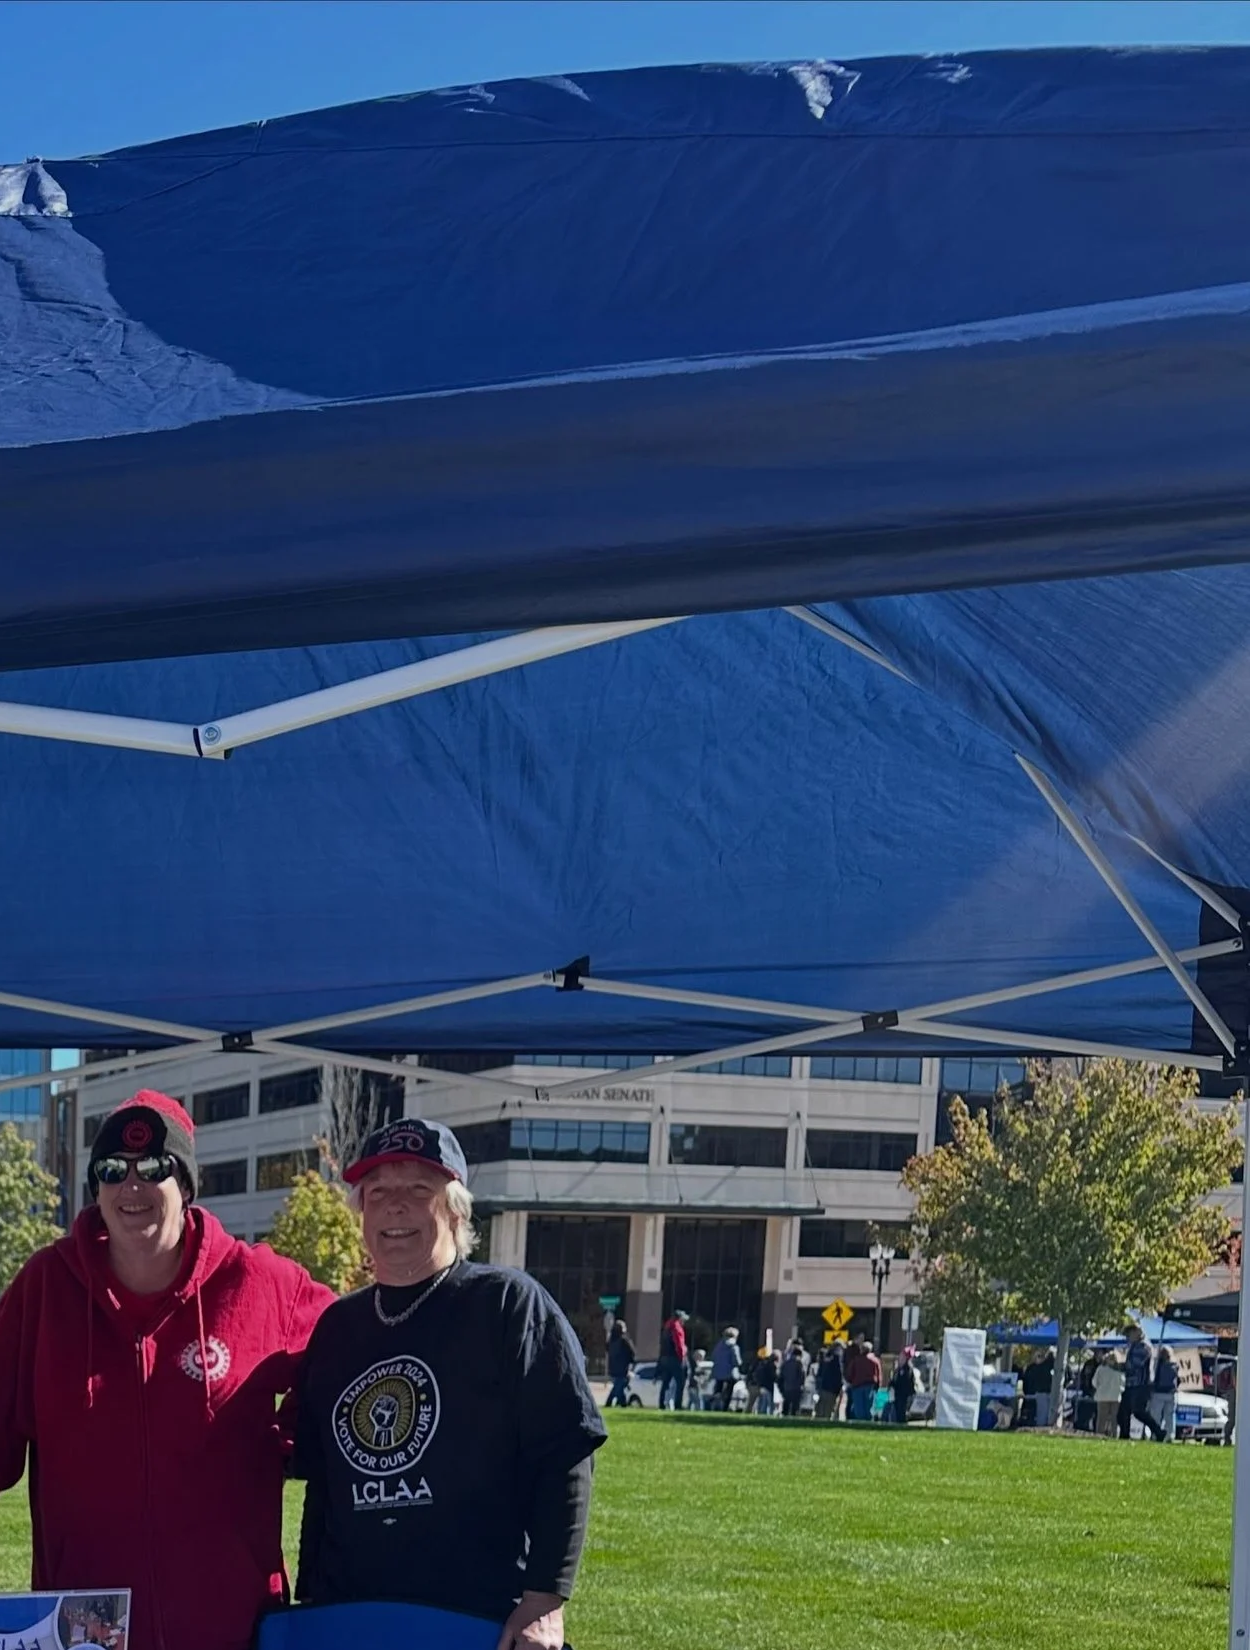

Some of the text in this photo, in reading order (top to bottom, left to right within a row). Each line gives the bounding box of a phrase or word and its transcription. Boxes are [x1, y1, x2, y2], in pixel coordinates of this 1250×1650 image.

[377, 1131, 425, 1156] 250
[343, 1362, 428, 1404] EMPOWER 2024
[337, 1403, 433, 1469] VOTE FOR OUR FUTURE
[351, 1475, 433, 1505] LCLAA
